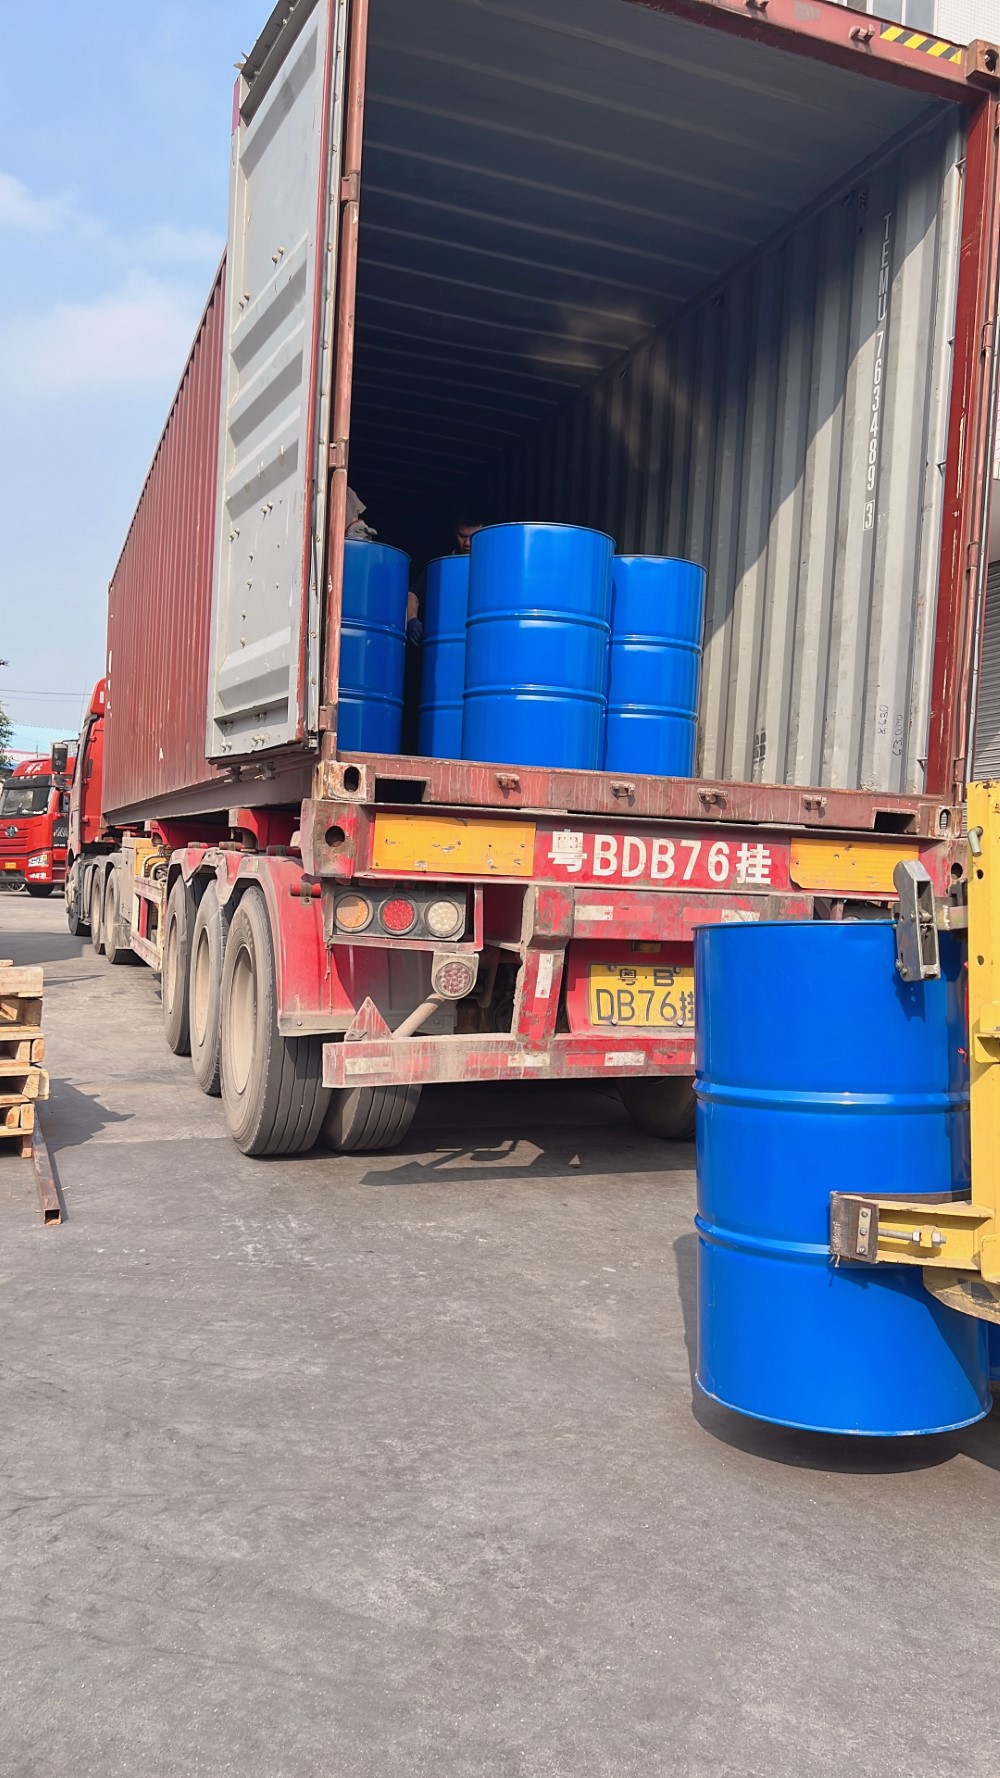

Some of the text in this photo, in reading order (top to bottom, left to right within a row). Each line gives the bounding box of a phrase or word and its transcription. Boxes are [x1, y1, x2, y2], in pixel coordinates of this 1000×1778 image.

[864, 212, 892, 529] TEMU 763489 3
[547, 829, 772, 885] 粤BDB76挂
